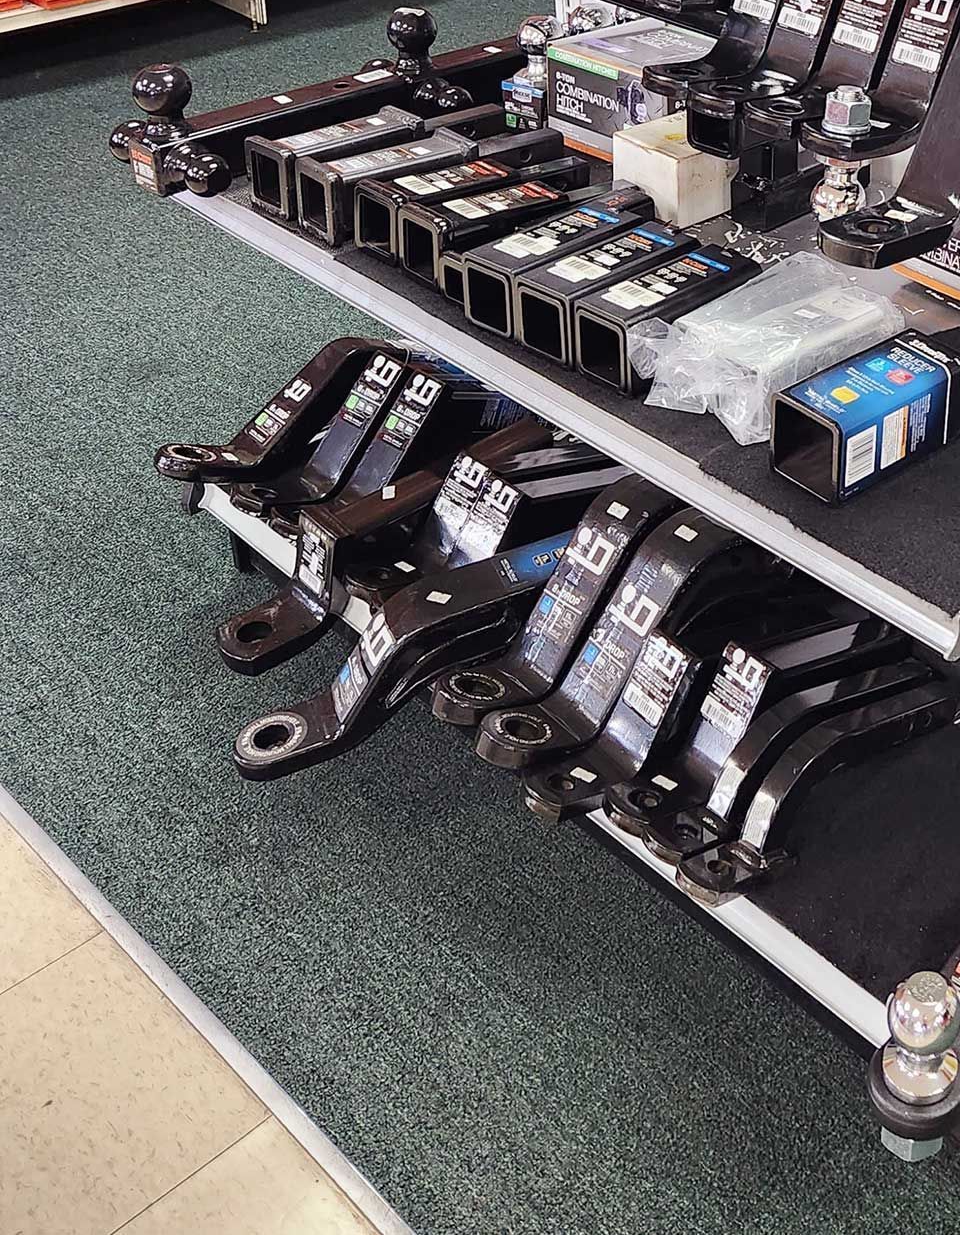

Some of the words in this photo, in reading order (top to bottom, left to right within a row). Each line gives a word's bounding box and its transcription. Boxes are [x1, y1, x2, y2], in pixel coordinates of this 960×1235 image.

[556, 80, 619, 113] COMBINATION
[556, 93, 584, 113] HITCH
[887, 353, 925, 375] SLEEVE
[890, 347, 937, 373] REDUCER
